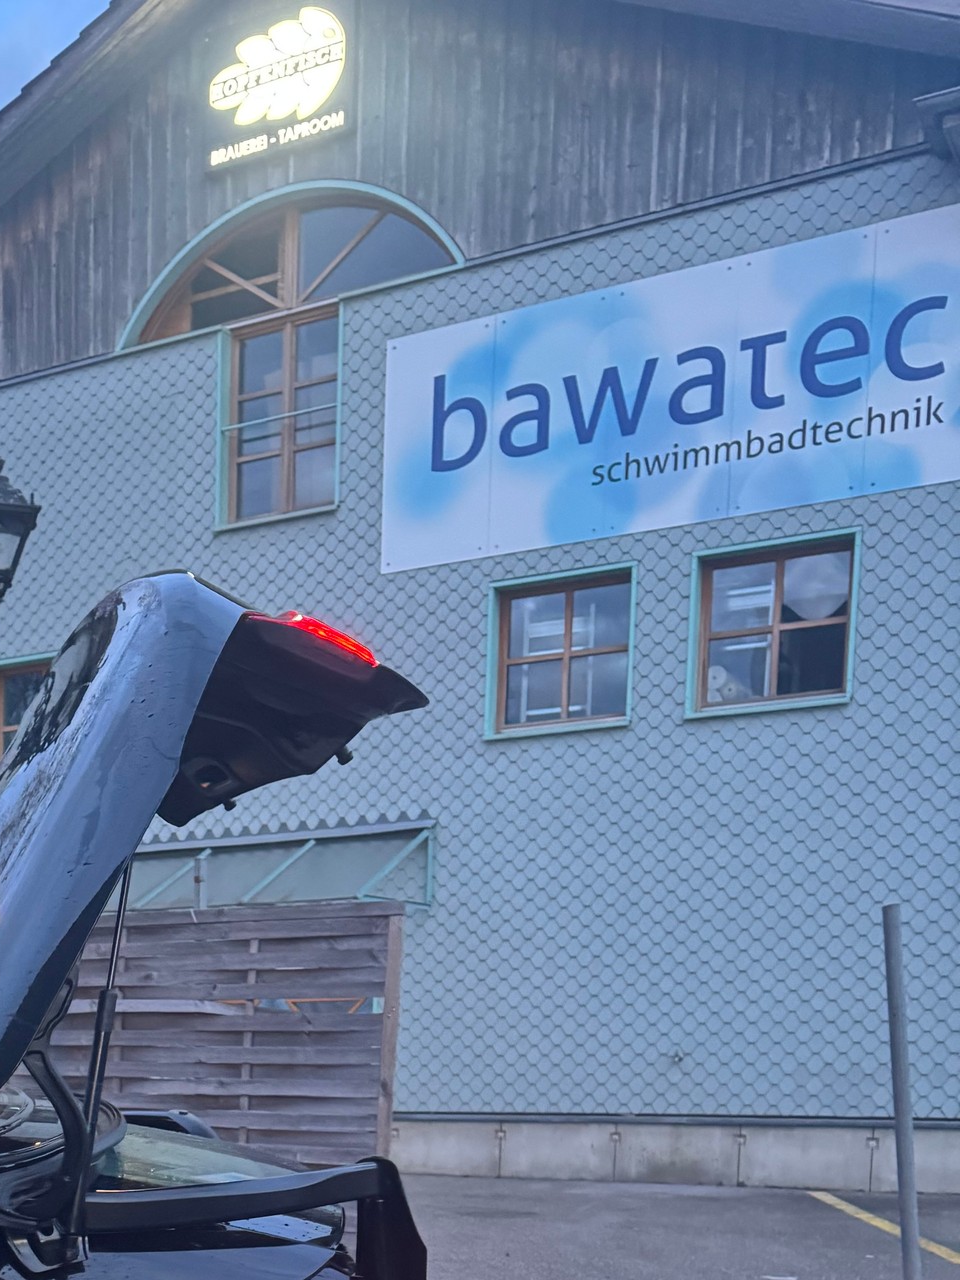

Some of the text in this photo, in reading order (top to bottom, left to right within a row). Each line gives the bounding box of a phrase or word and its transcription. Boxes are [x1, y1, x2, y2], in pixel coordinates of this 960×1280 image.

[210, 134, 268, 166] BRAUEREI
[277, 110, 345, 145] TAPROOM
[430, 295, 949, 473] bawatec
[591, 396, 946, 486] schwimmbadtechnik
